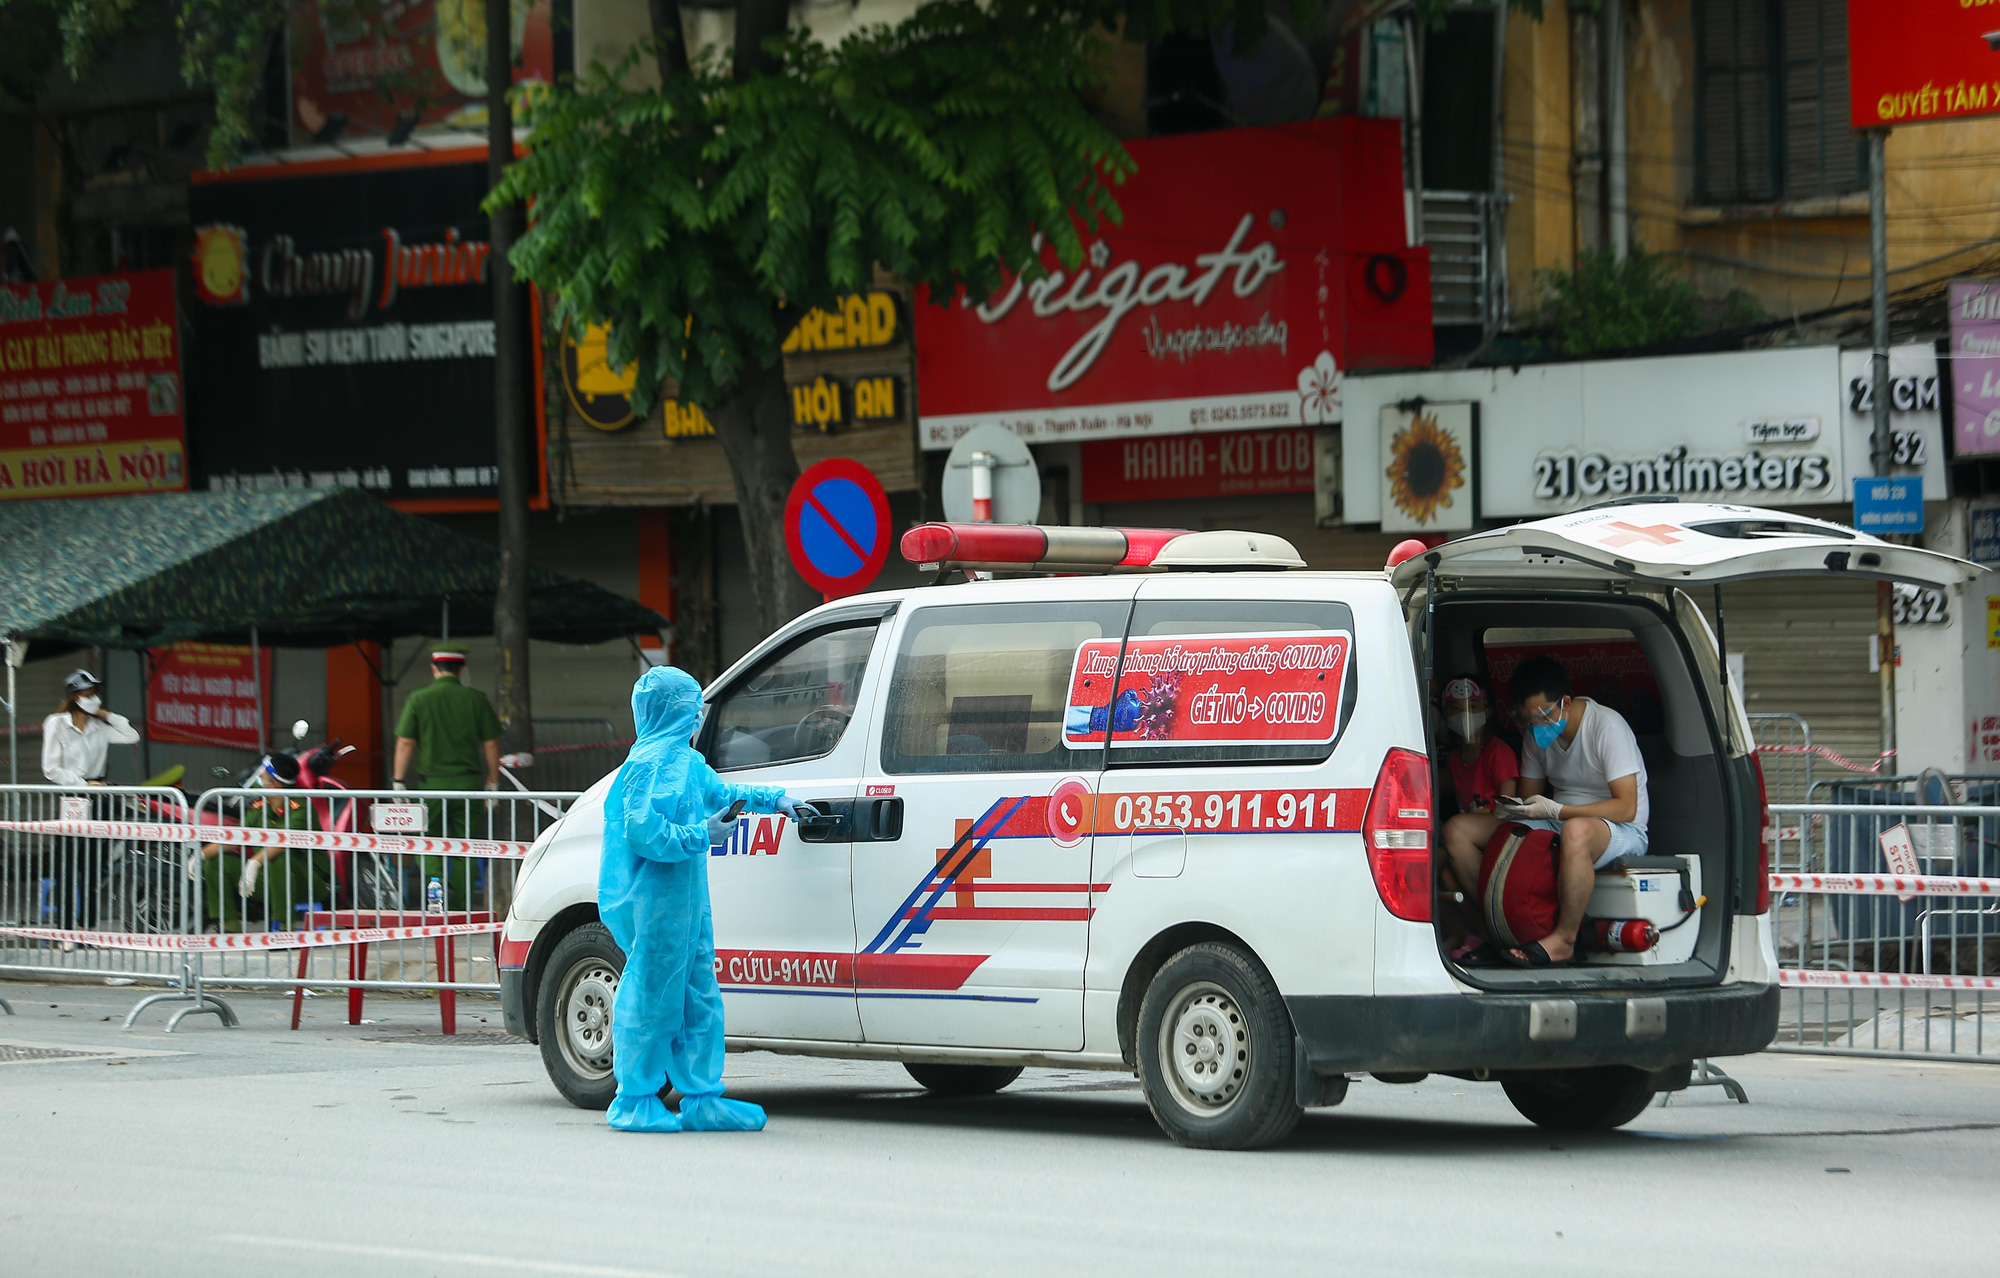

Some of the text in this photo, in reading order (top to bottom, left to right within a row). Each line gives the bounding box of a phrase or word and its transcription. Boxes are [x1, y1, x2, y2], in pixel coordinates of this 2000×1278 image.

[1877, 80, 1940, 120] QUYẾT
[1943, 79, 1988, 114] TÂM
[377, 225, 491, 310] Junior
[781, 290, 898, 354] READ
[794, 376, 842, 432] HỘI
[856, 377, 895, 419] AN
[1891, 377, 1941, 412] CM
[1045, 417, 1076, 433] Thanh
[1081, 416, 1108, 431] Xuân
[75, 446, 113, 484] HÀ
[119, 441, 168, 491] NỘI
[1120, 647, 1159, 678] phong
[1160, 643, 1183, 673] hỗ
[1179, 648, 1202, 677] trợ
[1199, 646, 1243, 677] phòng
[1242, 643, 1279, 674] chống
[1279, 642, 1342, 671] COVID19
[156, 698, 197, 726] KHÔNG
[1190, 683, 1326, 725] GIẾT NÓ COVID19
[384, 816, 413, 826] STOP
[1114, 793, 1339, 830] 0353.911.911
[1890, 845, 1905, 875] STO
[729, 952, 838, 984] CỨU-911AV
